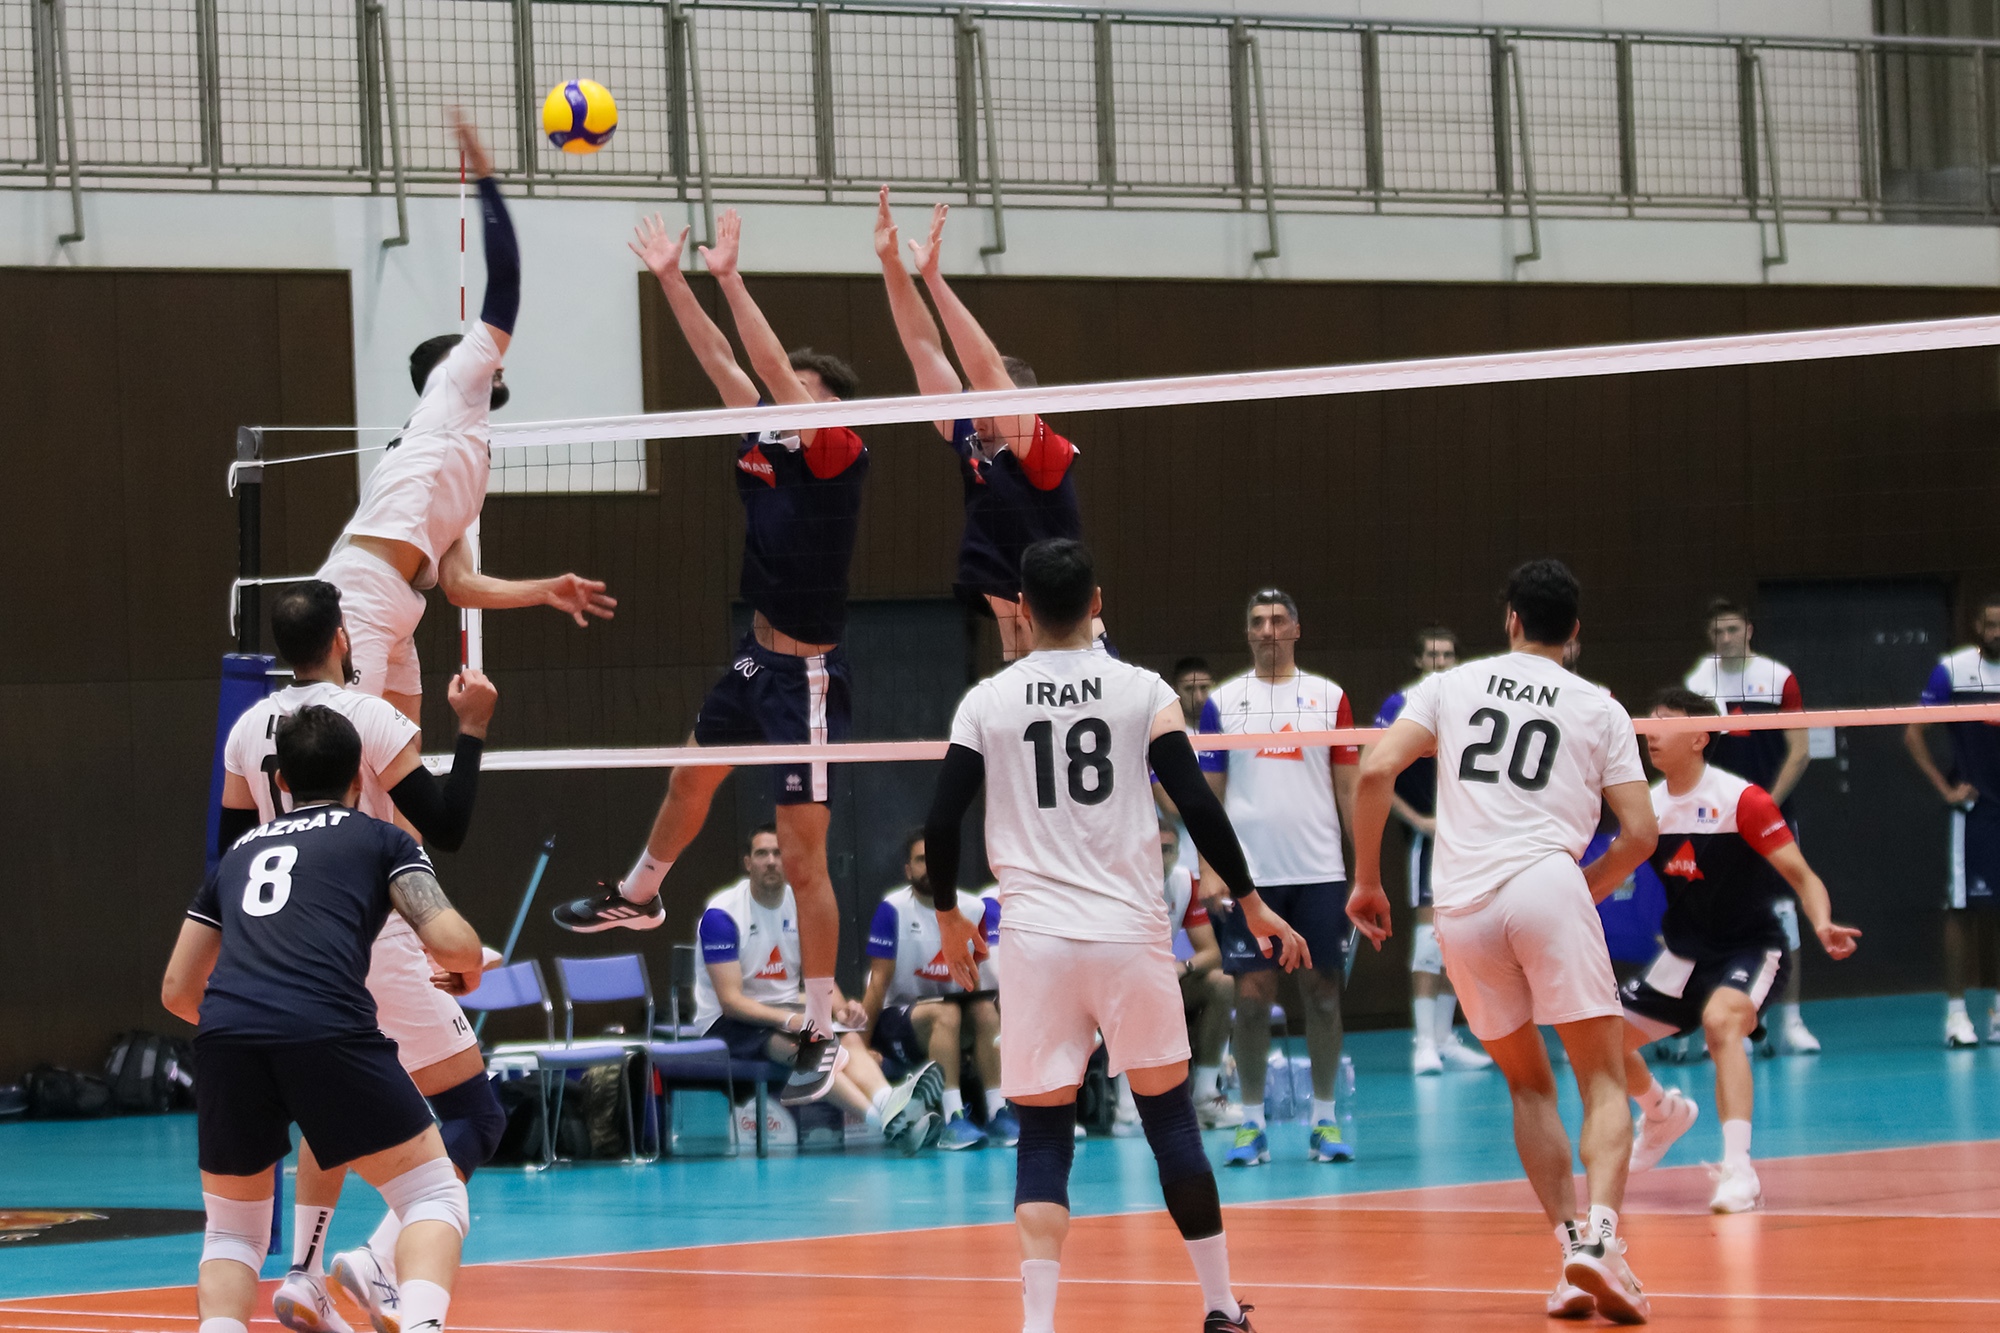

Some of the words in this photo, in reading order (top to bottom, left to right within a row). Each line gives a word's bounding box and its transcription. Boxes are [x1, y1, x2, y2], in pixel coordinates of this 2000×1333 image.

[738, 459, 774, 475] MAIF
[1026, 677, 1102, 707] IRAN
[1486, 675, 1561, 708] IRAN
[1023, 717, 1114, 809] 18
[1459, 707, 1561, 792] 20
[233, 810, 351, 851] HAZRAT
[242, 846, 299, 918] 8
[452, 1015, 469, 1037] 14
